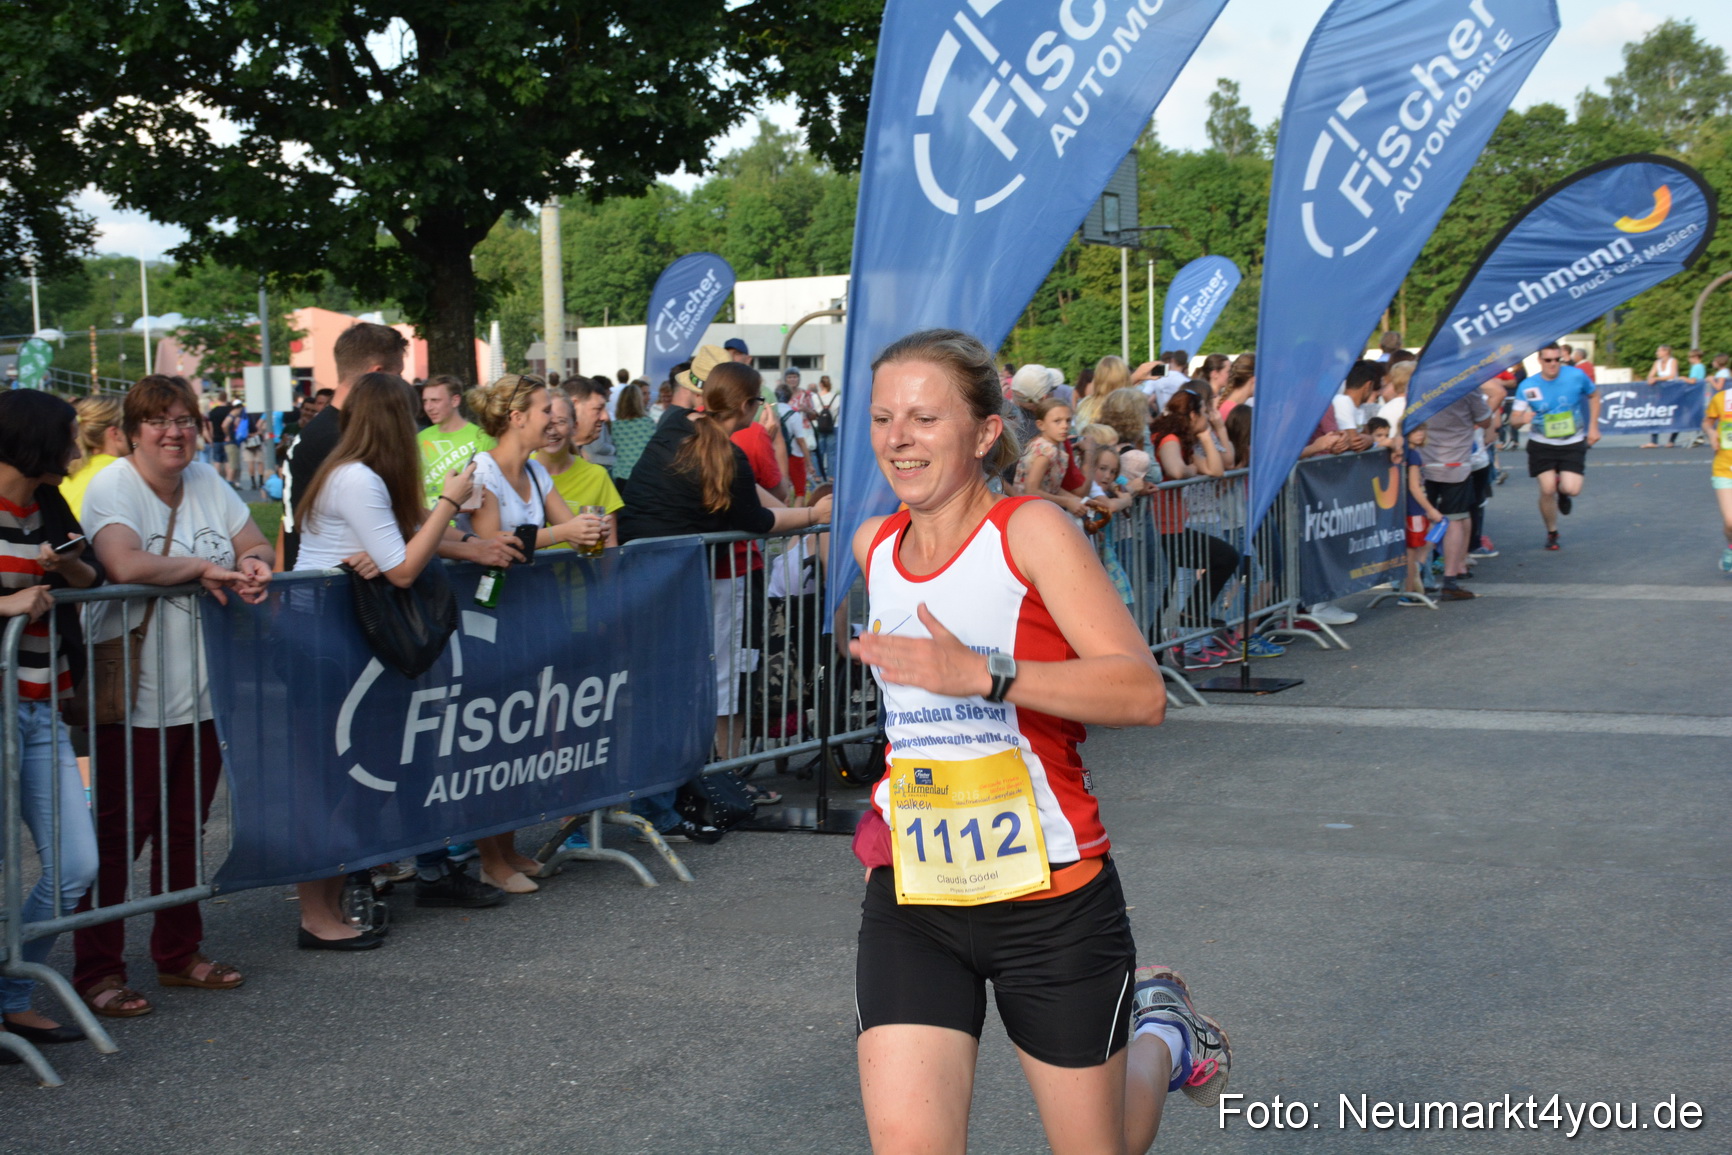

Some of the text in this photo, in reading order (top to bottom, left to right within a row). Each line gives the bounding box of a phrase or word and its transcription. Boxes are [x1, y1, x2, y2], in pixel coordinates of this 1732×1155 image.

[968, 0, 1117, 162] Fisc
[1338, 0, 1495, 219] Fischer
[1393, 28, 1513, 214] AUTOMOBILE
[1452, 236, 1635, 346] Frischmann
[1568, 222, 1699, 300] Druck und Medien
[666, 268, 717, 341] Fischer
[1180, 268, 1224, 330] Fischer
[1607, 402, 1679, 420] Fischer
[400, 665, 629, 765] Fischer
[898, 706, 953, 725] machen
[954, 703, 984, 721] Sie
[423, 737, 611, 808] AUTOMOBILE
[907, 783, 949, 796] firmenlauf
[906, 811, 1028, 864] 1112
[936, 870, 999, 885] Claudia Gödel
